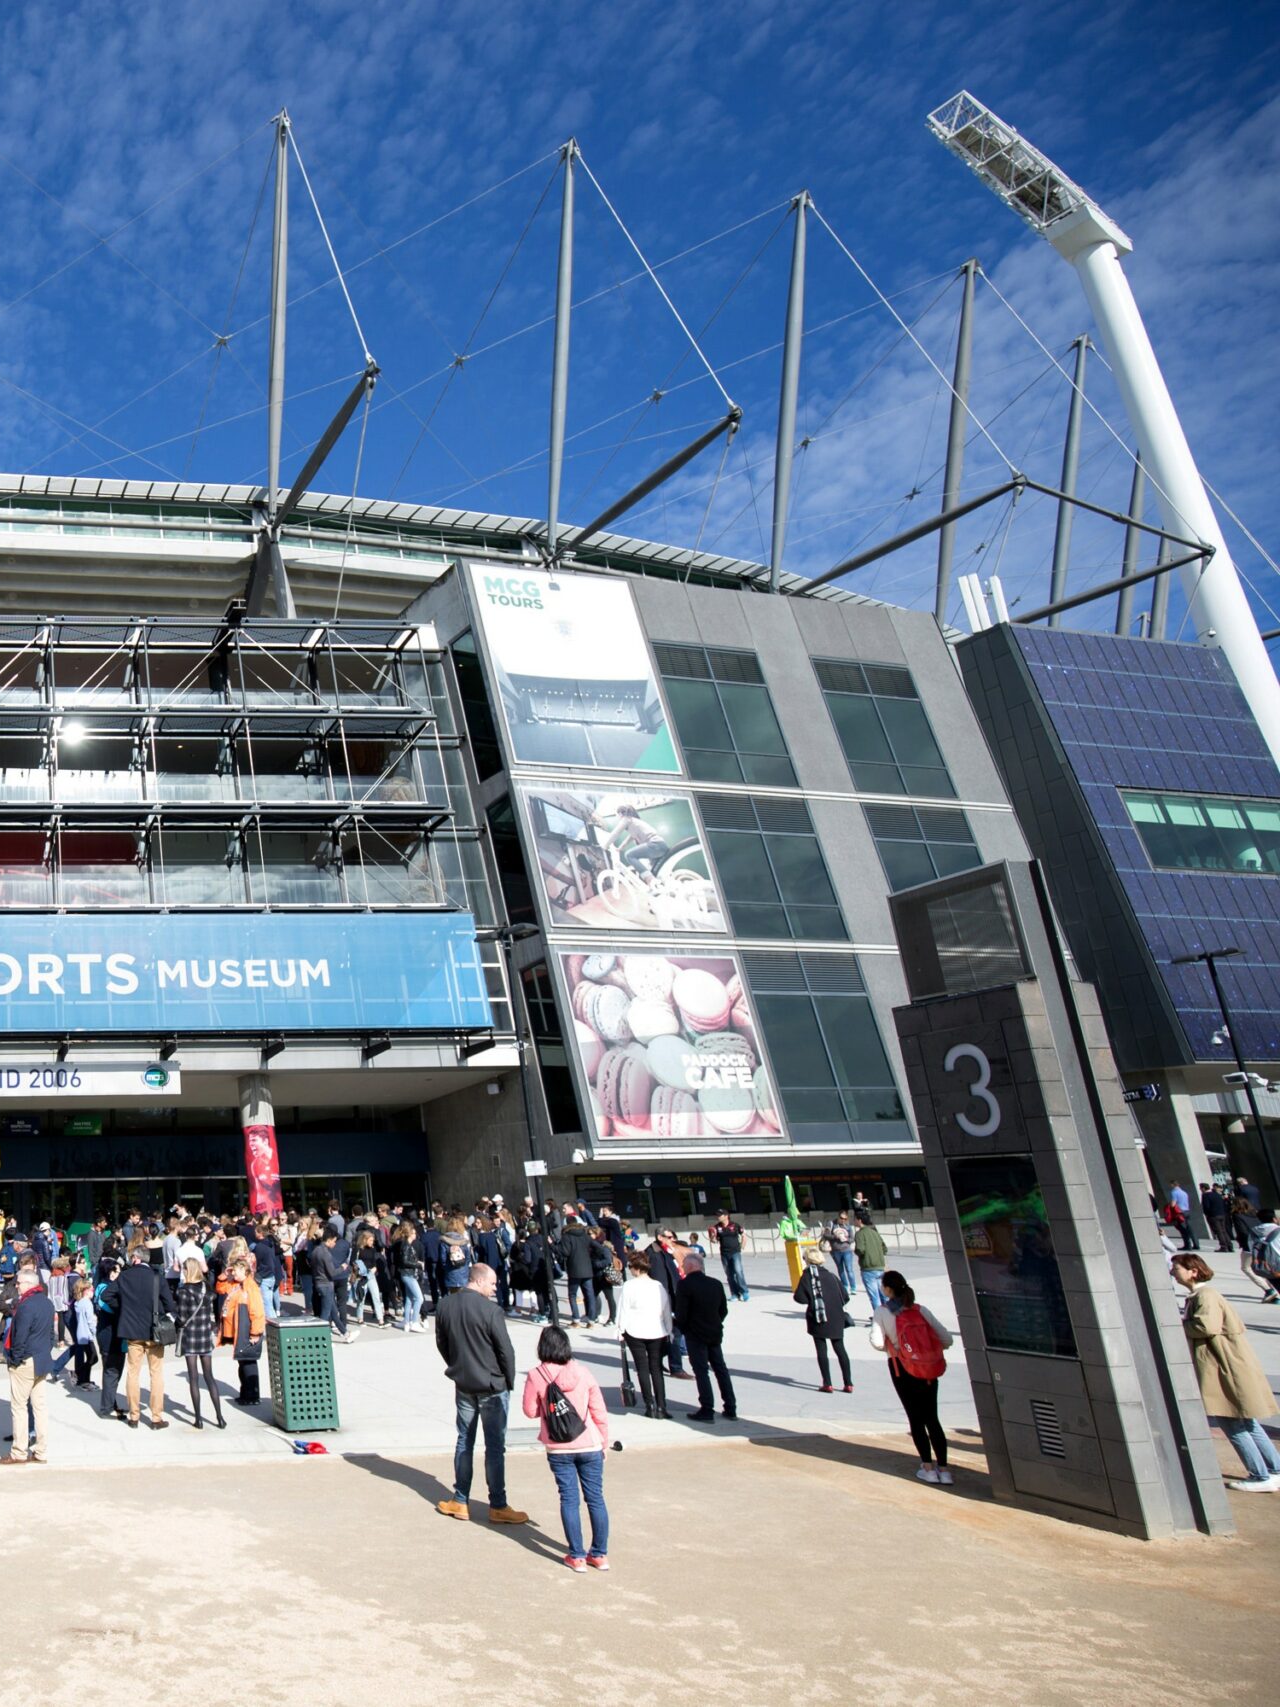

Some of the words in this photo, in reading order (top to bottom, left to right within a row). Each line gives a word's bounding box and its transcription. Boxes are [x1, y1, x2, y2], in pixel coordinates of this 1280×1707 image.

[483, 575, 541, 598] MCG
[487, 593, 544, 610] TOURS
[157, 958, 331, 989] MUSEUM
[680, 1053, 750, 1068] PADDOCK
[29, 1068, 82, 1088] 2006
[684, 1067, 756, 1090] CAFE
[944, 1043, 1002, 1137] 3
[676, 1175, 705, 1184] Tickets
